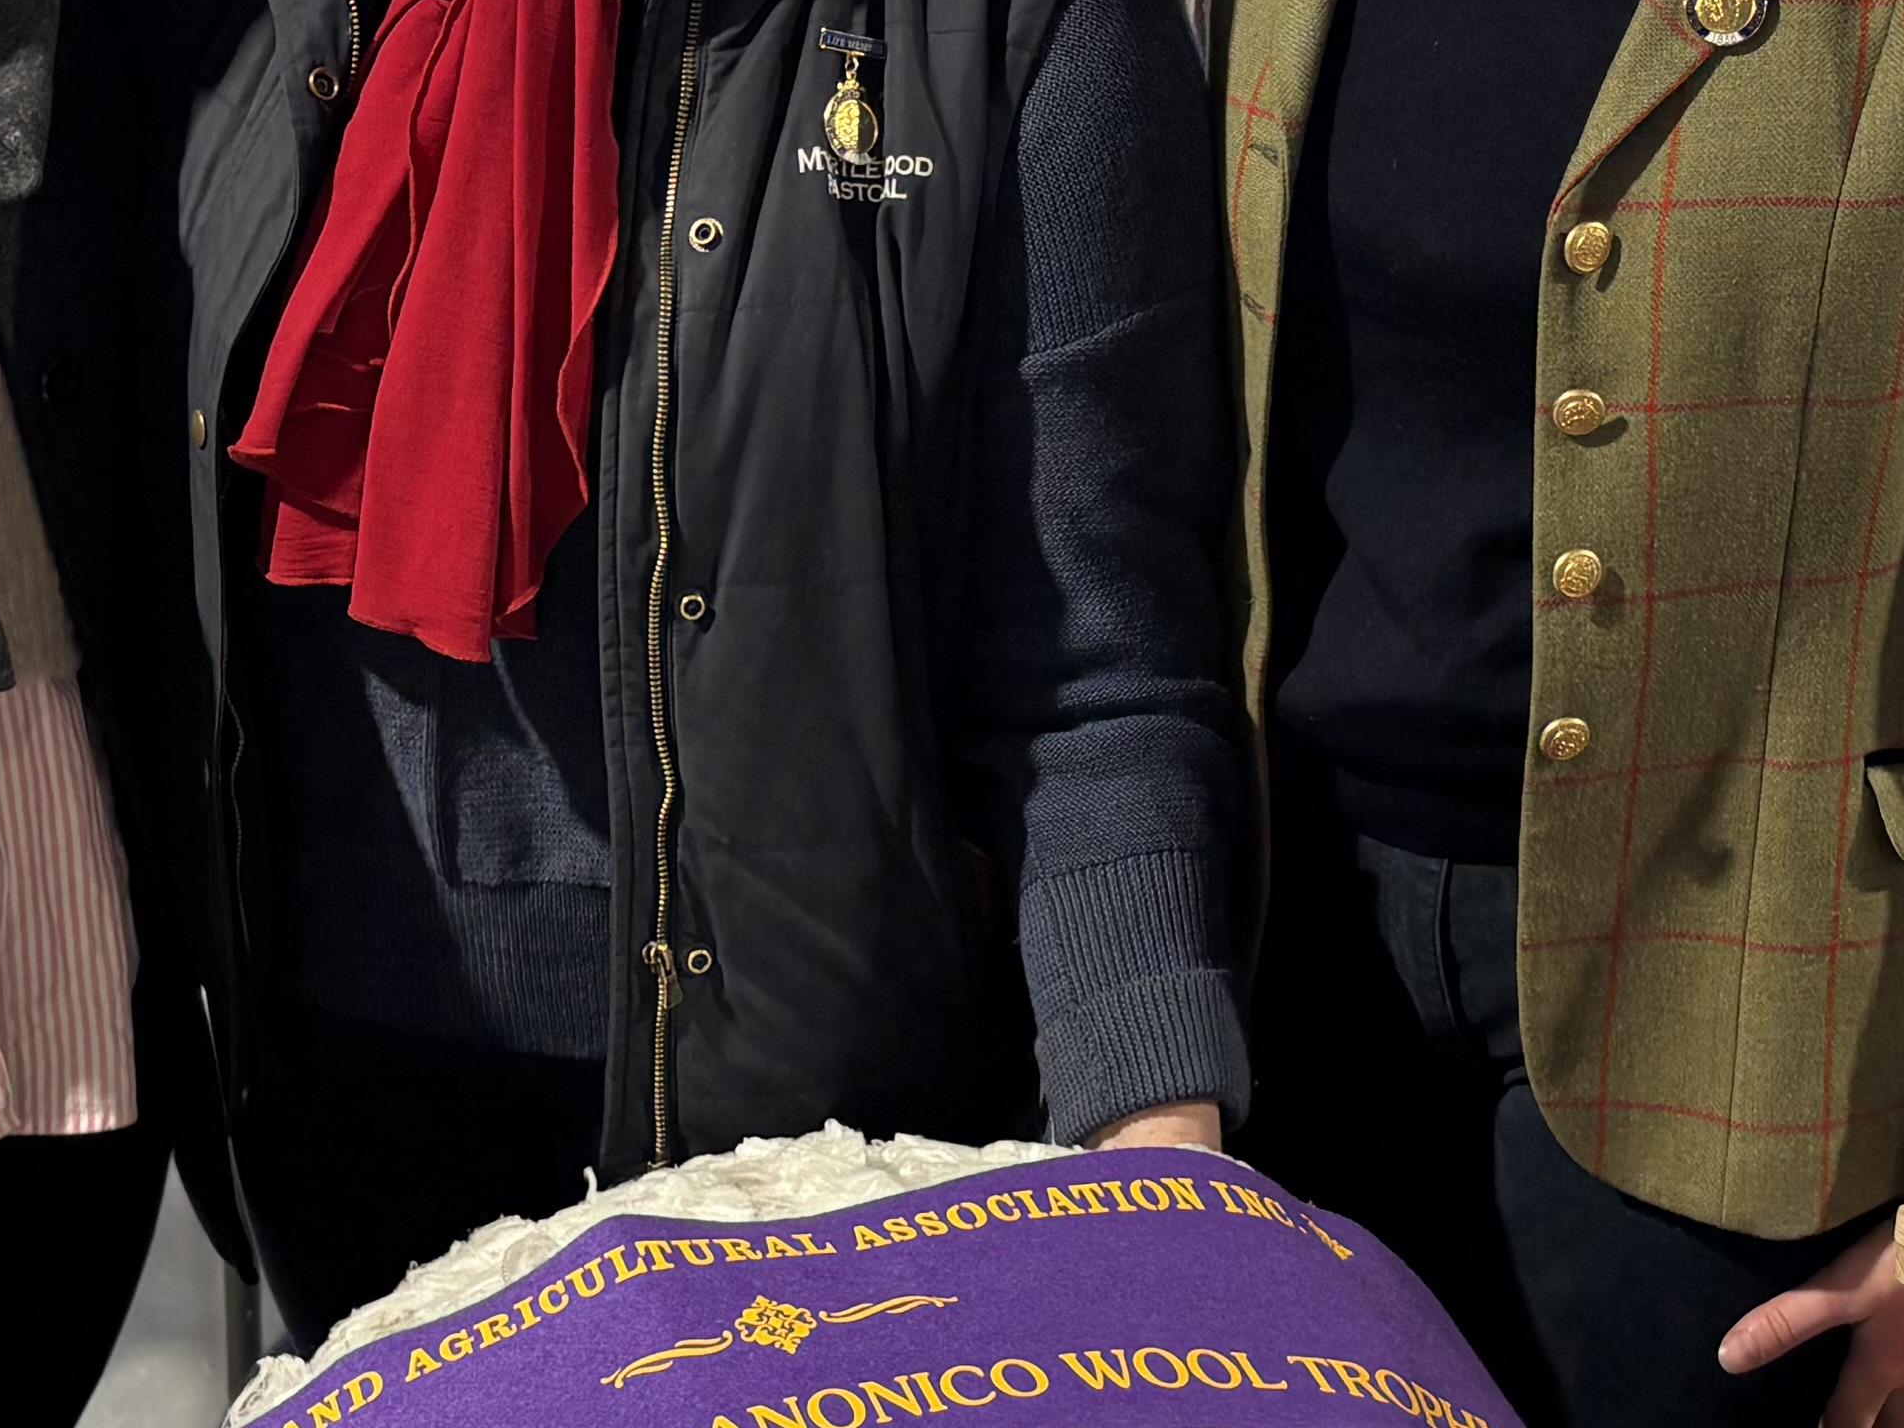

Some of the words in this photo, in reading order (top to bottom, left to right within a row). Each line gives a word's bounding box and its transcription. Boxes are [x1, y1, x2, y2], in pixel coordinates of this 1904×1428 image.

[403, 1231, 836, 1384] AGRICULTURAL
[852, 1175, 1206, 1254] ASSOCIATION
[1058, 1346, 1290, 1392] WOOL
